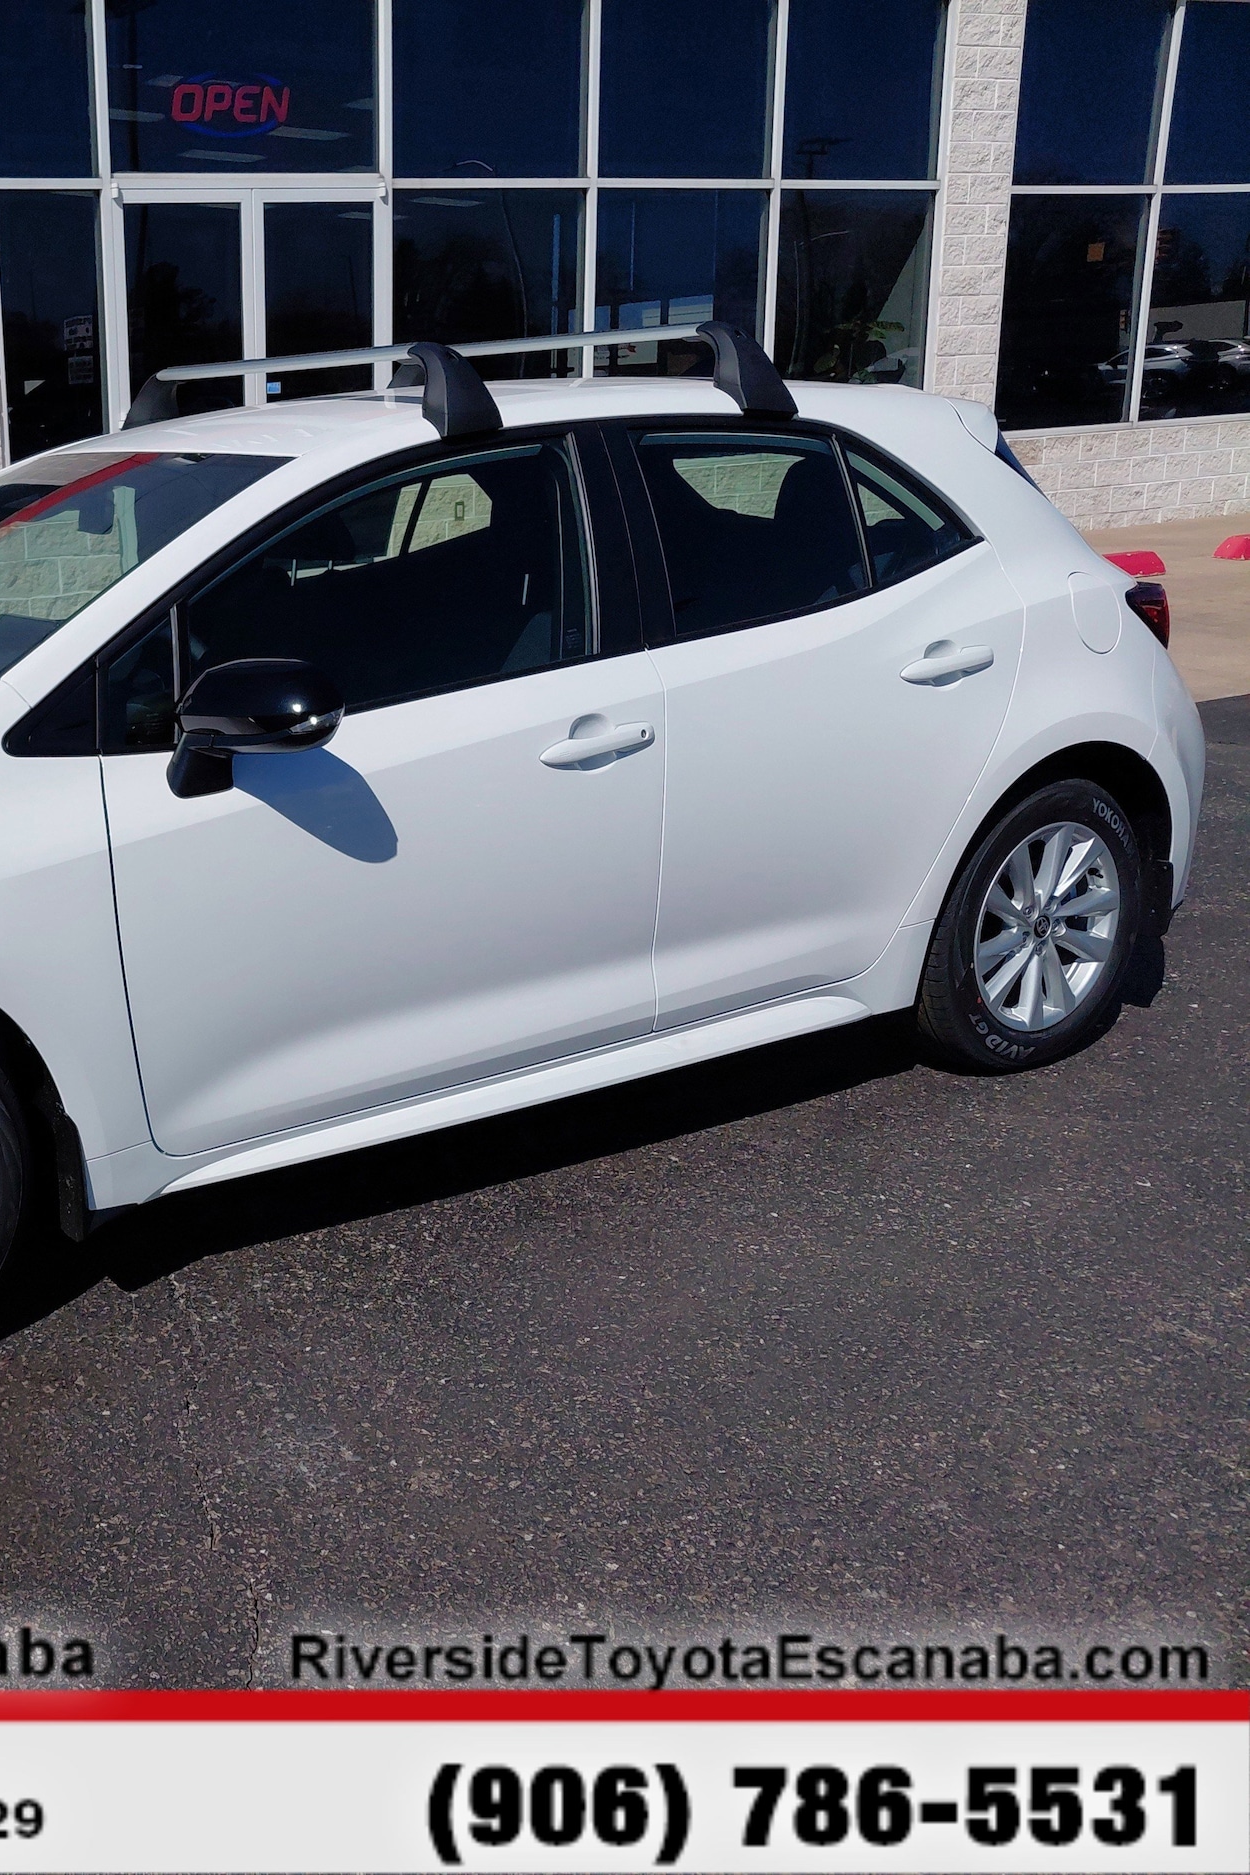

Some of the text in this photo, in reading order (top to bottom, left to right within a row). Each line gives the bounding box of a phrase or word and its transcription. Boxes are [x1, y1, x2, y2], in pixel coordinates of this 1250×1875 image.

[171, 83, 291, 122] OPEN
[1092, 797, 1133, 856] YOKOHA
[968, 1013, 989, 1035] GT
